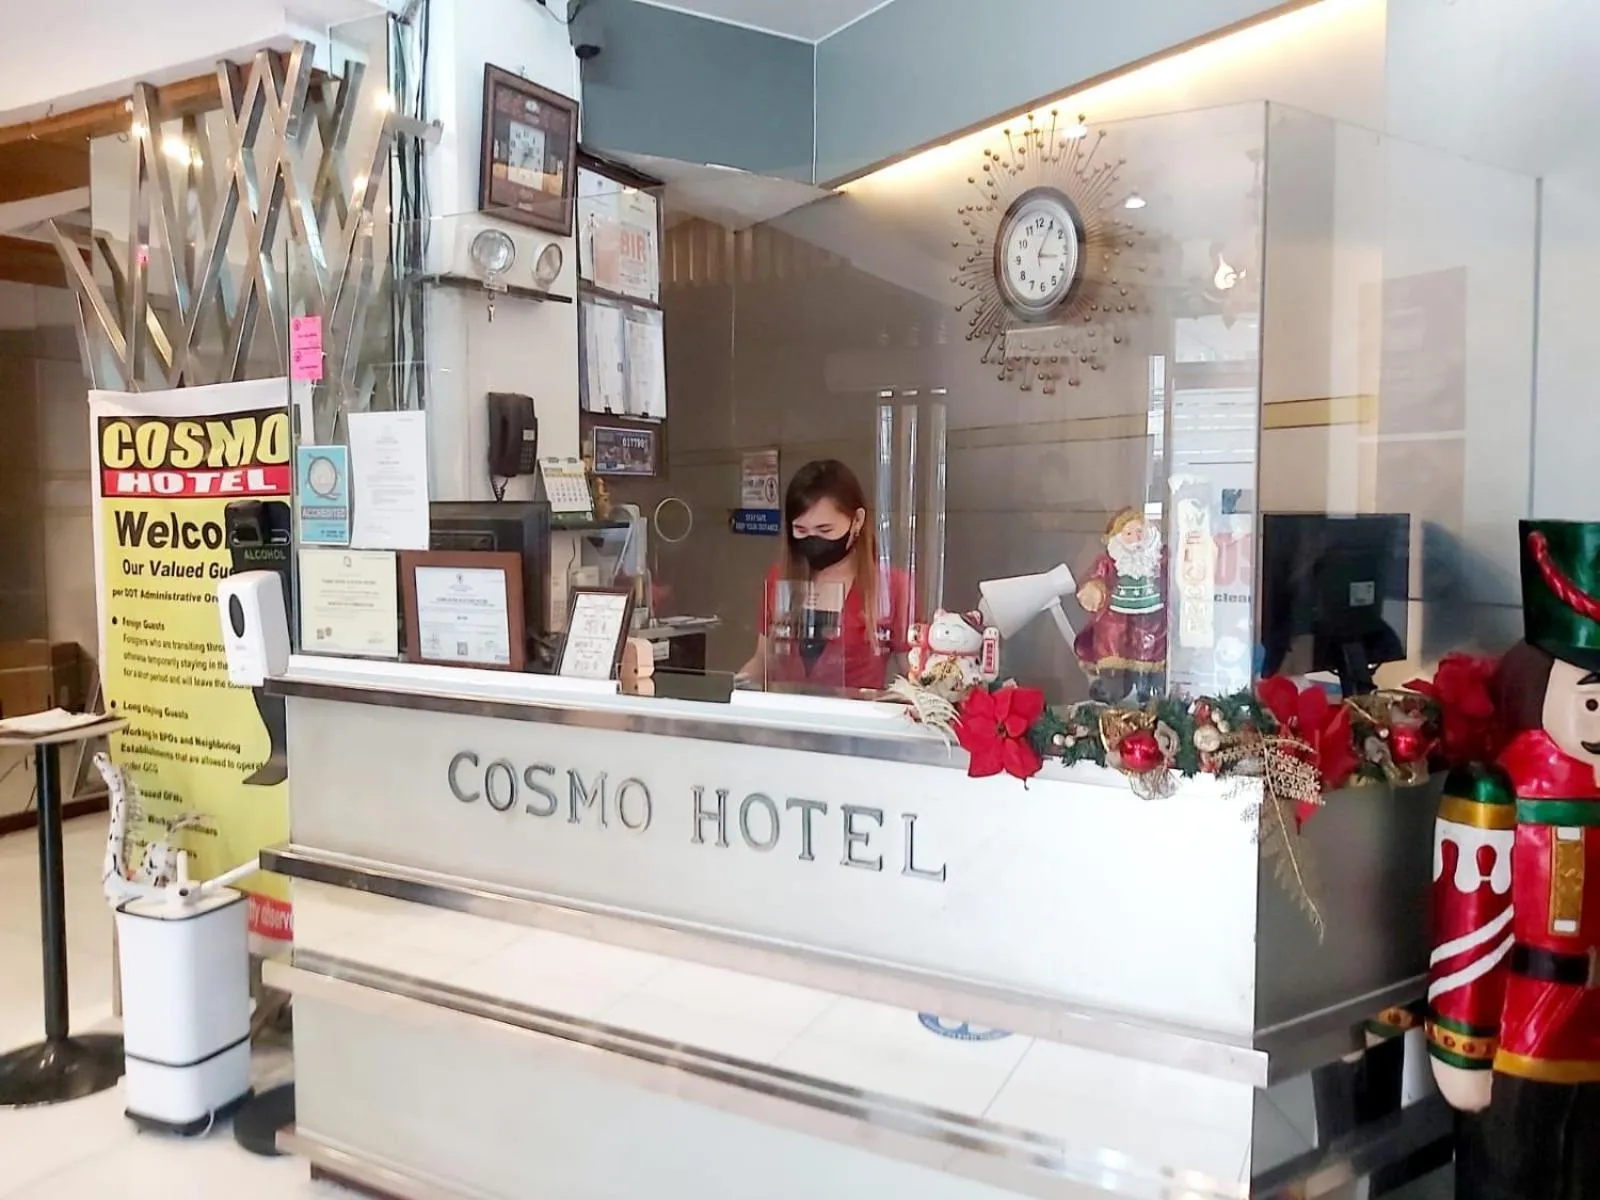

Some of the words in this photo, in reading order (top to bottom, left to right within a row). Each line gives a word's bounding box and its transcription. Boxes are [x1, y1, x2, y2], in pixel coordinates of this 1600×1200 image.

[1035, 217, 1044, 228] 12
[1026, 226, 1033, 236] 11
[1057, 228, 1063, 240] 2
[620, 229, 646, 263] BIR
[1019, 240, 1028, 249] 10
[1016, 255, 1021, 265] 9
[1020, 271, 1026, 281] 8
[1051, 275, 1057, 286] 5
[1029, 280, 1035, 290] 7
[1040, 282, 1046, 292] 6
[102, 413, 289, 469] COSMO
[117, 469, 276, 494] HOTEL
[114, 511, 229, 550] Welco
[244, 548, 286, 560] ALCOHOL
[122, 558, 144, 576] Our
[149, 560, 204, 578] Valued
[112, 589, 123, 598] per
[140, 588, 202, 603] Administrative
[143, 619, 165, 631] Guests
[181, 658, 207, 671] staying
[209, 661, 215, 670] in
[217, 661, 229, 670] the
[123, 668, 132, 676] for
[182, 676, 193, 687] will
[194, 676, 214, 688] leave
[214, 678, 226, 689] the
[123, 700, 141, 713] Long
[164, 706, 188, 719] Guests
[122, 724, 152, 741] Working
[180, 735, 193, 745] and
[195, 736, 240, 754] Neighboring
[448, 751, 652, 834] COSMO
[690, 785, 947, 882] HOTEL
